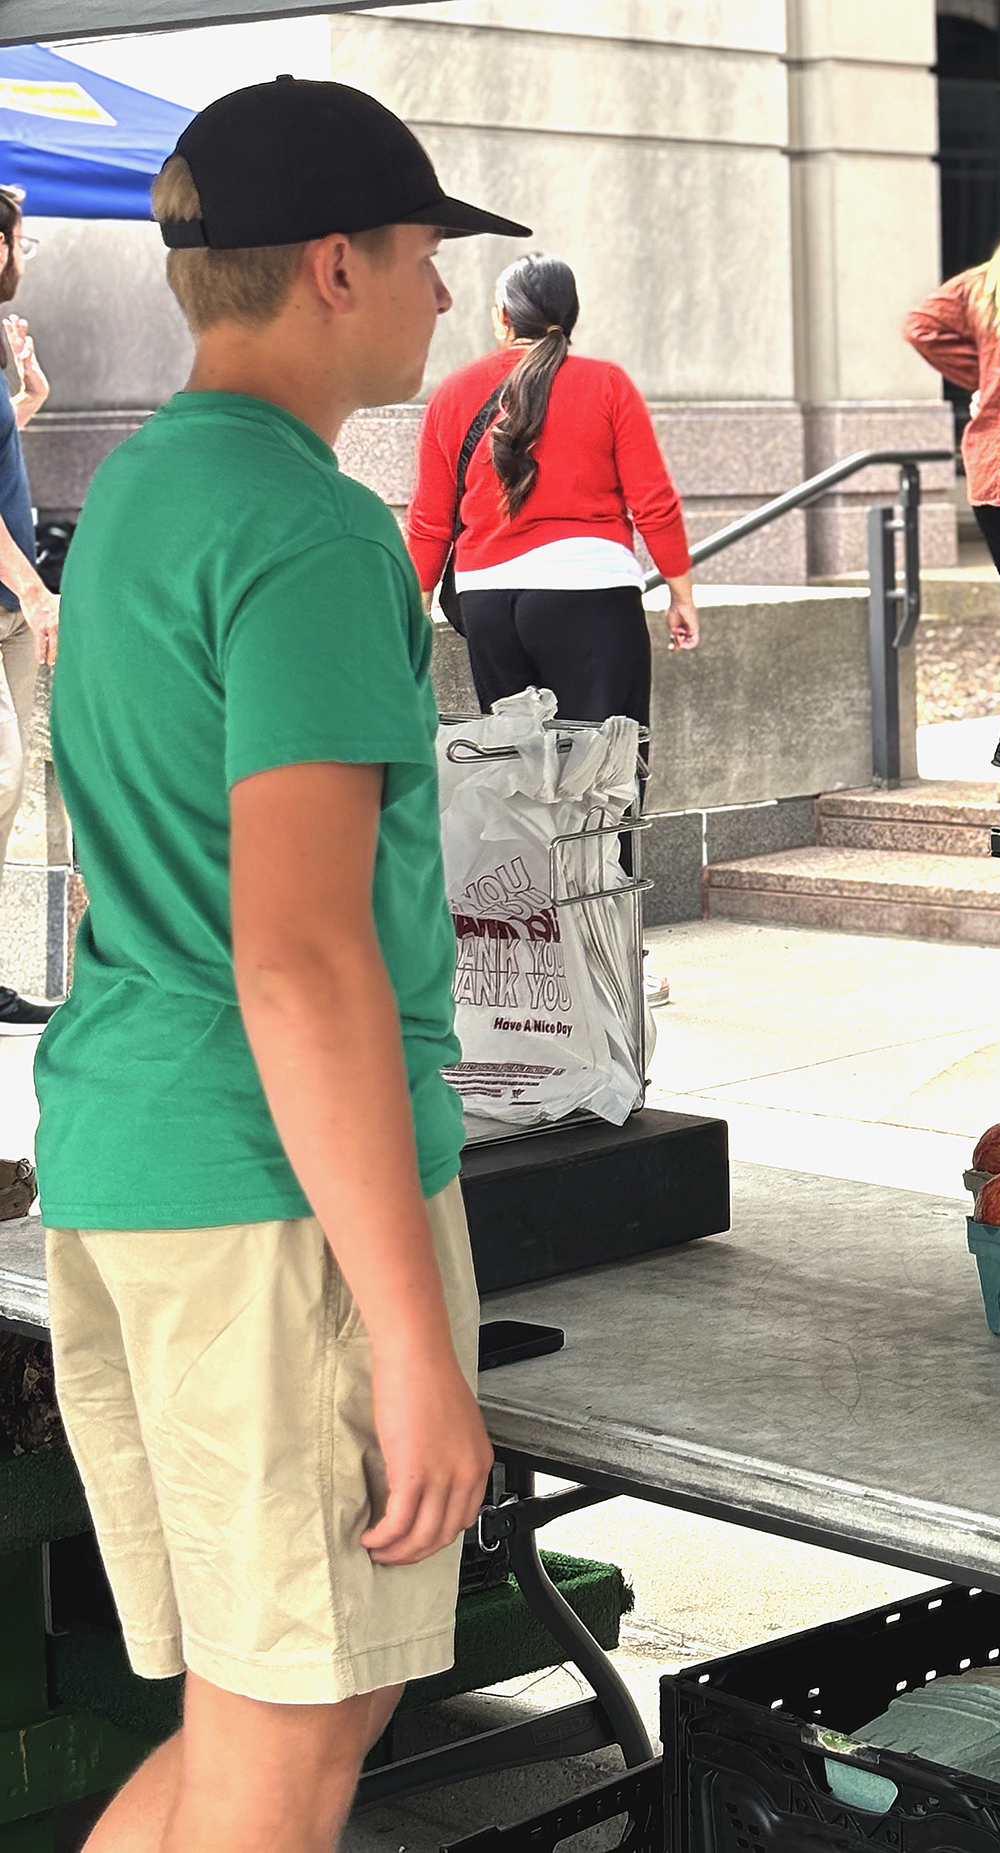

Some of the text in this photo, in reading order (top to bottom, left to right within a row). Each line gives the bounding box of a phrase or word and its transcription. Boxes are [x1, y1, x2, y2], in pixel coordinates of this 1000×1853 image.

[453, 968, 572, 1011] ANK YOU
[494, 1017, 573, 1038] Have A Nice Day
